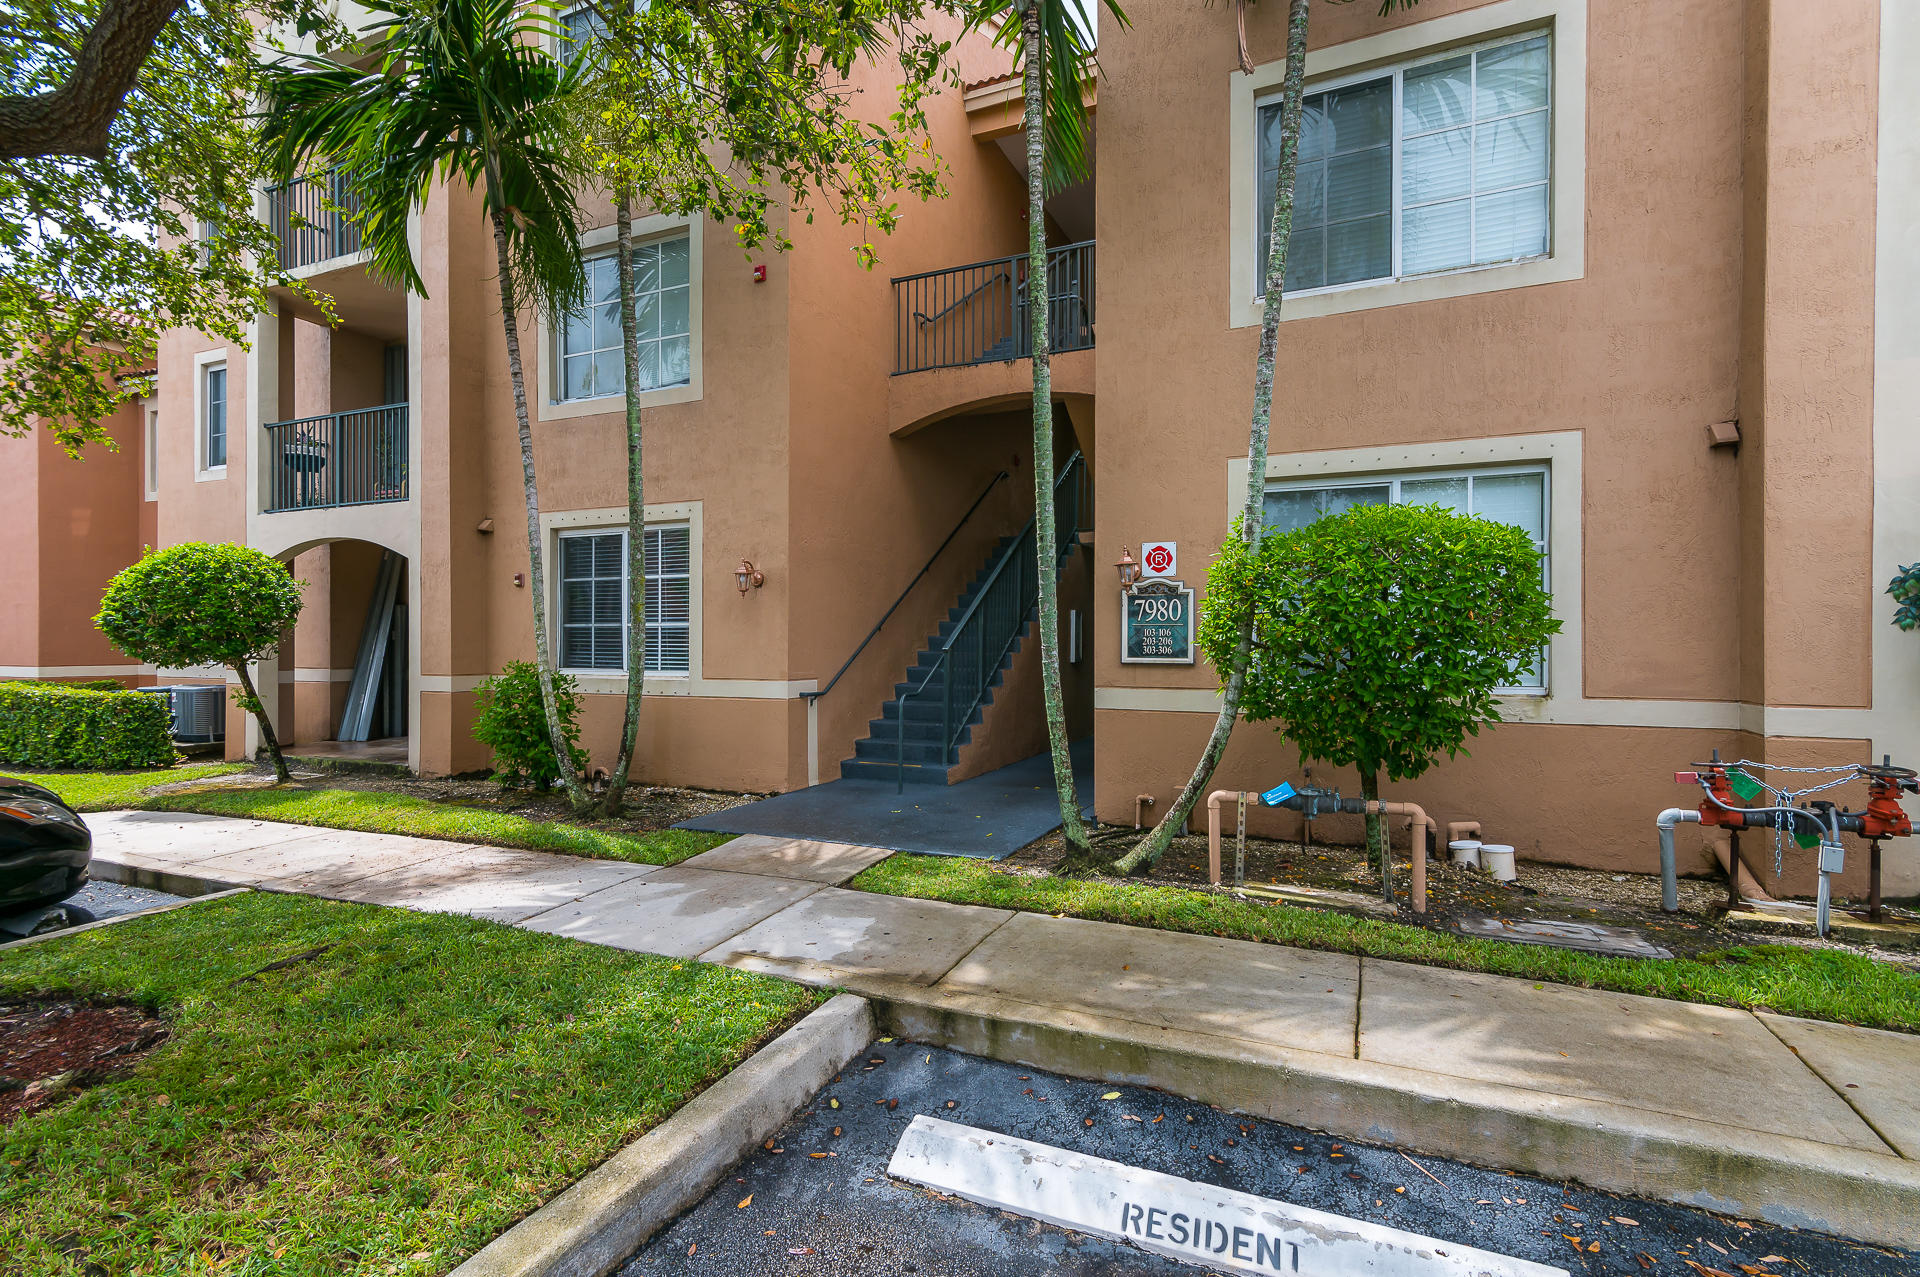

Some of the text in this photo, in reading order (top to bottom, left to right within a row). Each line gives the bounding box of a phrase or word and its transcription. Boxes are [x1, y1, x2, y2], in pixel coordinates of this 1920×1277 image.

[1155, 555, 1163, 564] R
[1134, 599, 1181, 622] 7980
[1144, 628, 1171, 637] 103-106
[1142, 637, 1172, 646] 203-206
[1142, 646, 1172, 655] 303-306
[1121, 1202, 1305, 1273] RESIDENT
